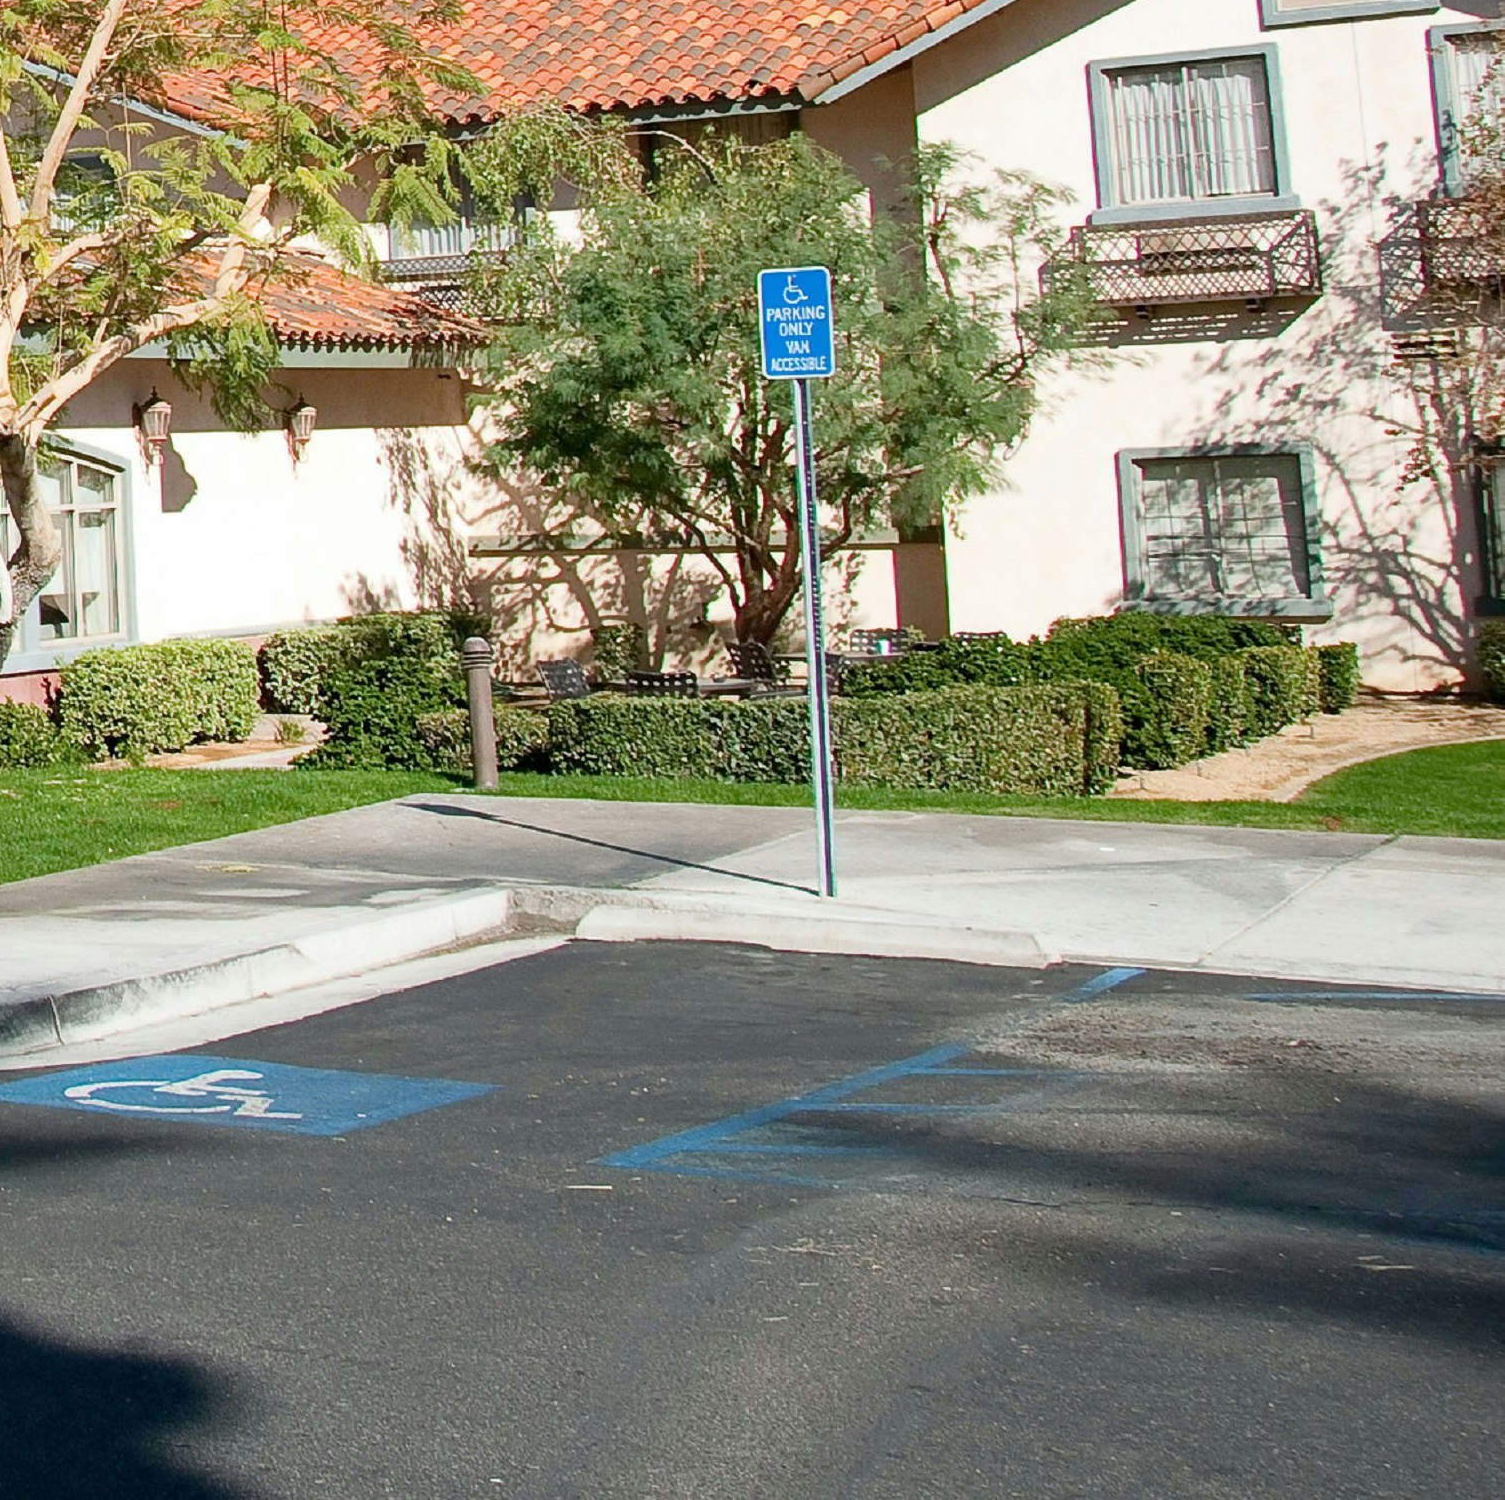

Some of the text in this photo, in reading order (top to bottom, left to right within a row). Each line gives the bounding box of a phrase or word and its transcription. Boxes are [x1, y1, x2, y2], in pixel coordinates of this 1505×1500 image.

[766, 305, 825, 321] PARKING
[779, 322, 813, 336] ONLY
[785, 340, 810, 354] VAN
[771, 356, 827, 372] ACCESSIBLE
